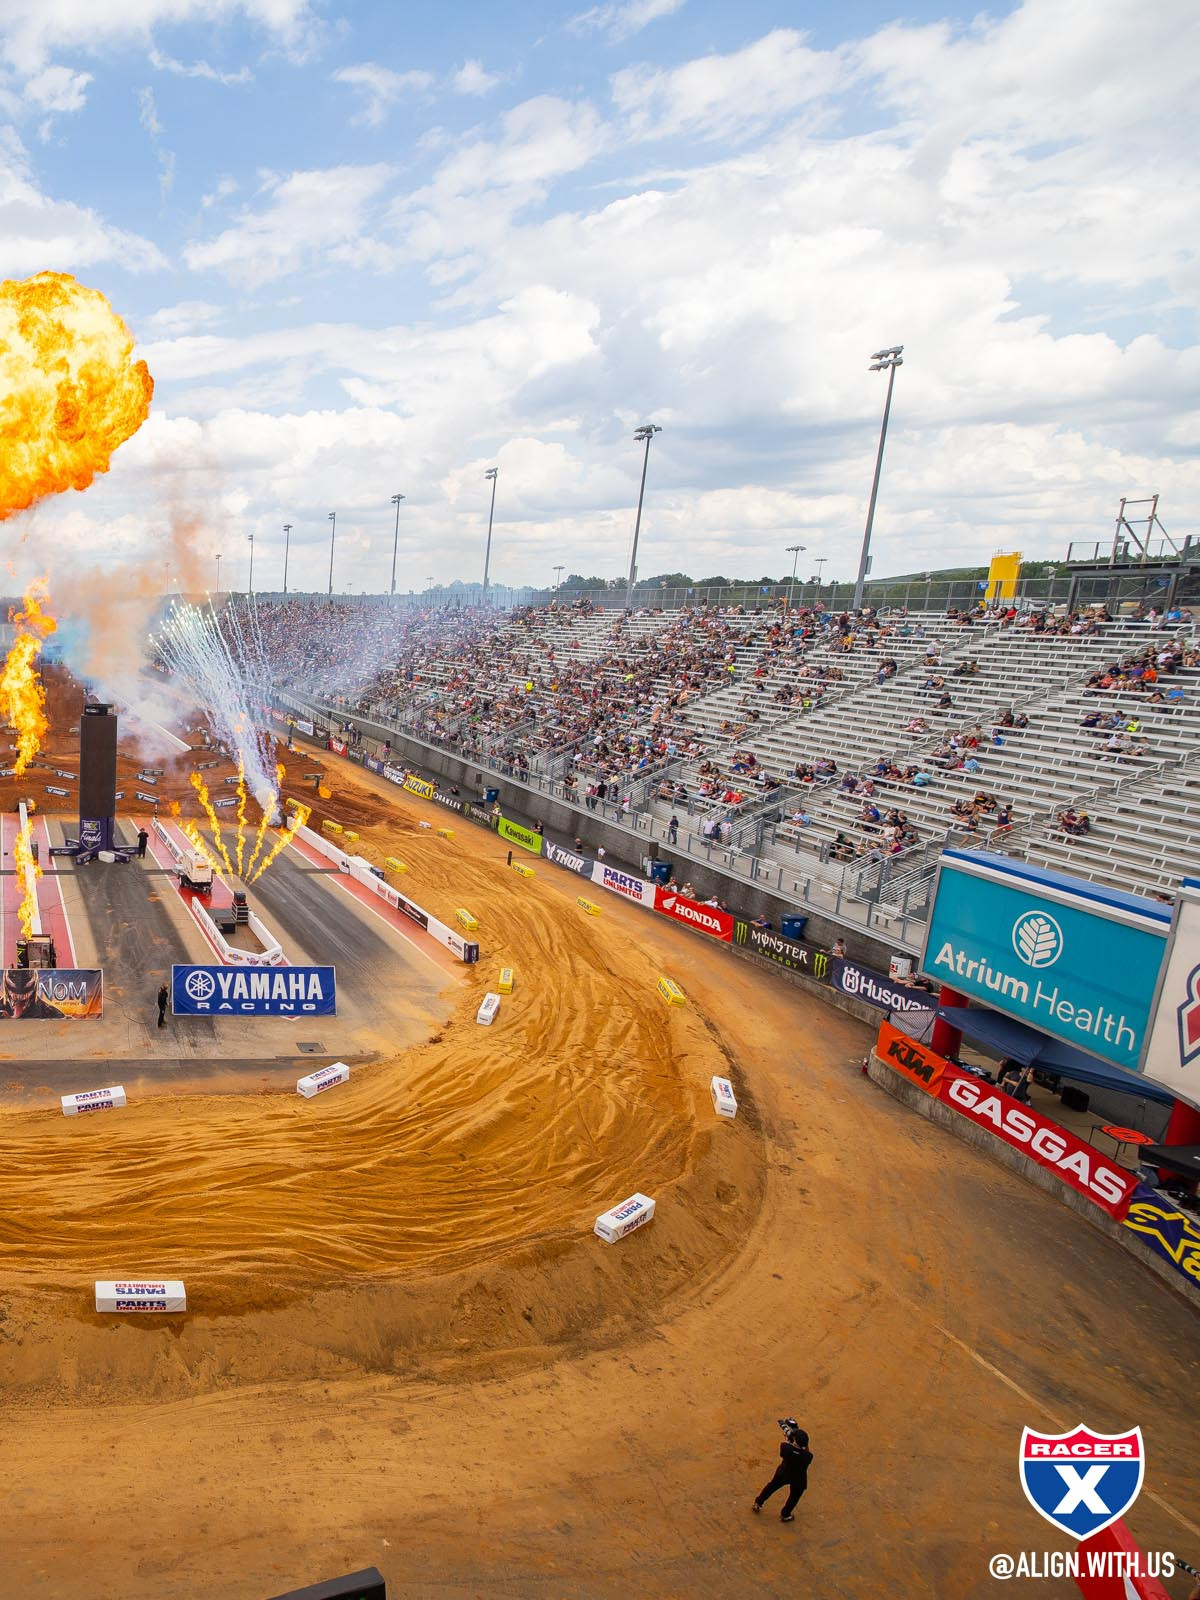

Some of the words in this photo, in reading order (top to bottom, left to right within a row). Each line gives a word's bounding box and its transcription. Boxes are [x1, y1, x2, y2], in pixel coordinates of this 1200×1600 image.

[438, 794, 461, 810] OAKLEY
[504, 824, 534, 846] Kawasaki
[555, 848, 585, 872] THOR
[603, 878, 642, 900] UNLIMITED
[604, 867, 643, 892] PARTS
[675, 902, 722, 932] HONDA
[751, 930, 808, 964] MONSTER
[758, 948, 799, 969] ENERGY
[217, 973, 323, 1000] YAMAHA
[934, 942, 1029, 1003] Atrium
[1033, 981, 1136, 1051] Health
[197, 1003, 316, 1011] RACING
[888, 1040, 935, 1084] KTM
[75, 1090, 111, 1100] PARTS
[78, 1100, 113, 1110] PARTS
[949, 1078, 1127, 1204] GASGAS
